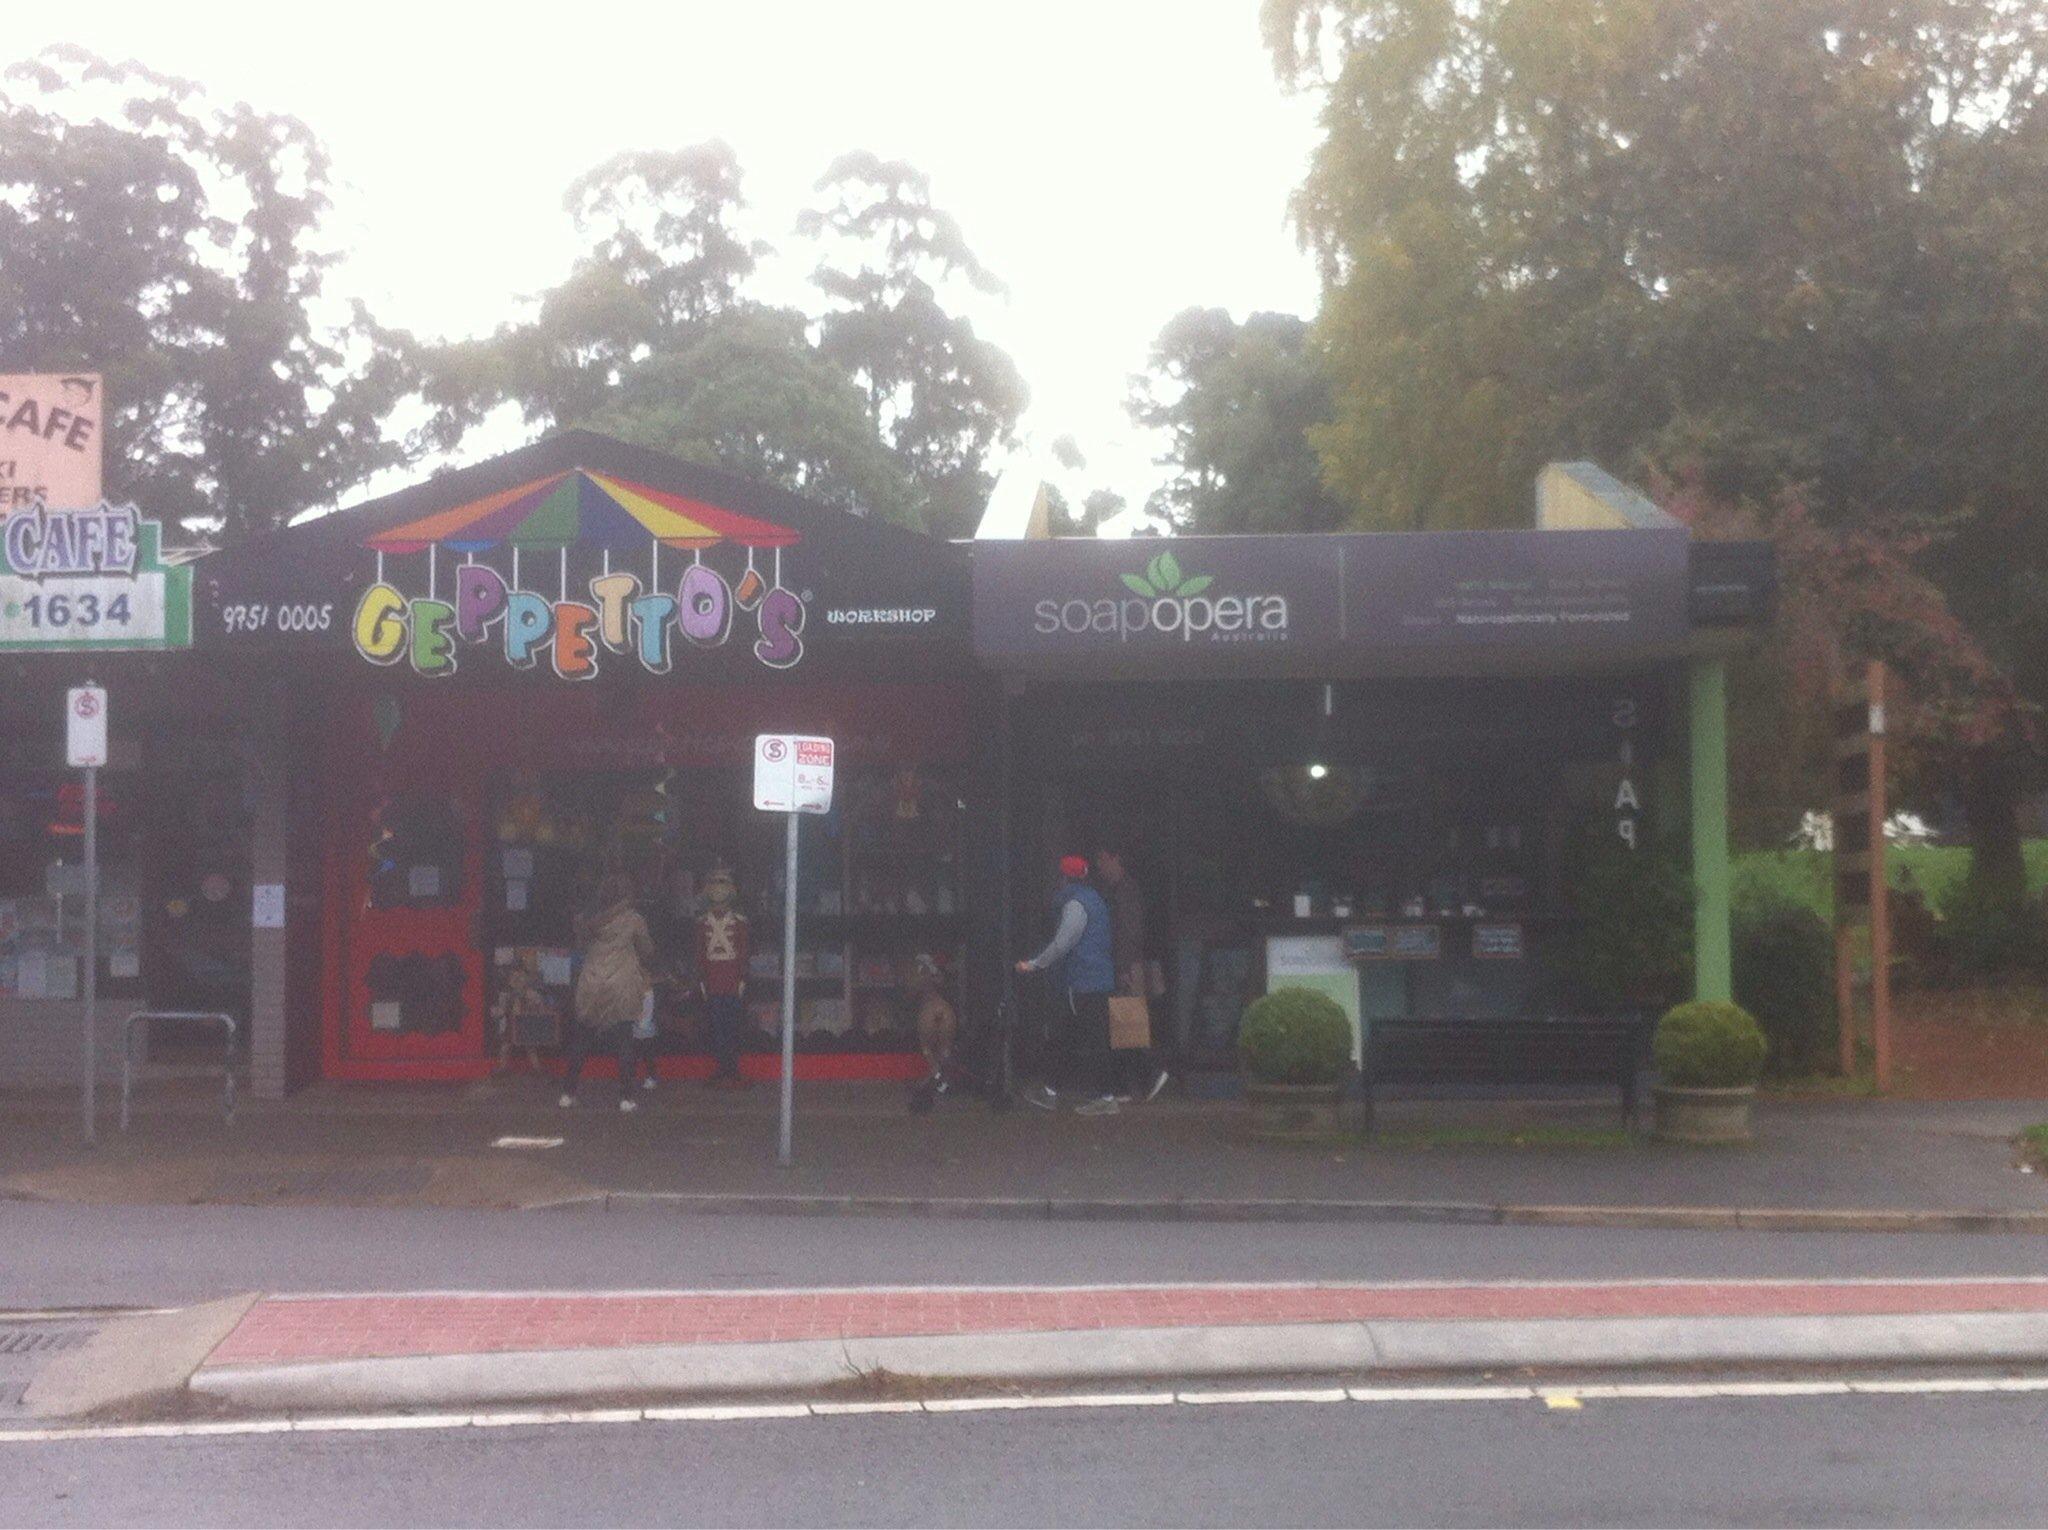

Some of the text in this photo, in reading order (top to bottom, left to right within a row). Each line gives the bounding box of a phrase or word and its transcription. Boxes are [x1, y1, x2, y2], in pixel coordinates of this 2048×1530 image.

[6, 501, 137, 576] CAFE
[24, 594, 131, 627] 1634
[223, 604, 333, 633] 9751 0005
[352, 563, 806, 680] GEPPETTO'S
[827, 609, 936, 623] WORKSHOP
[799, 754, 830, 765] ZONE
